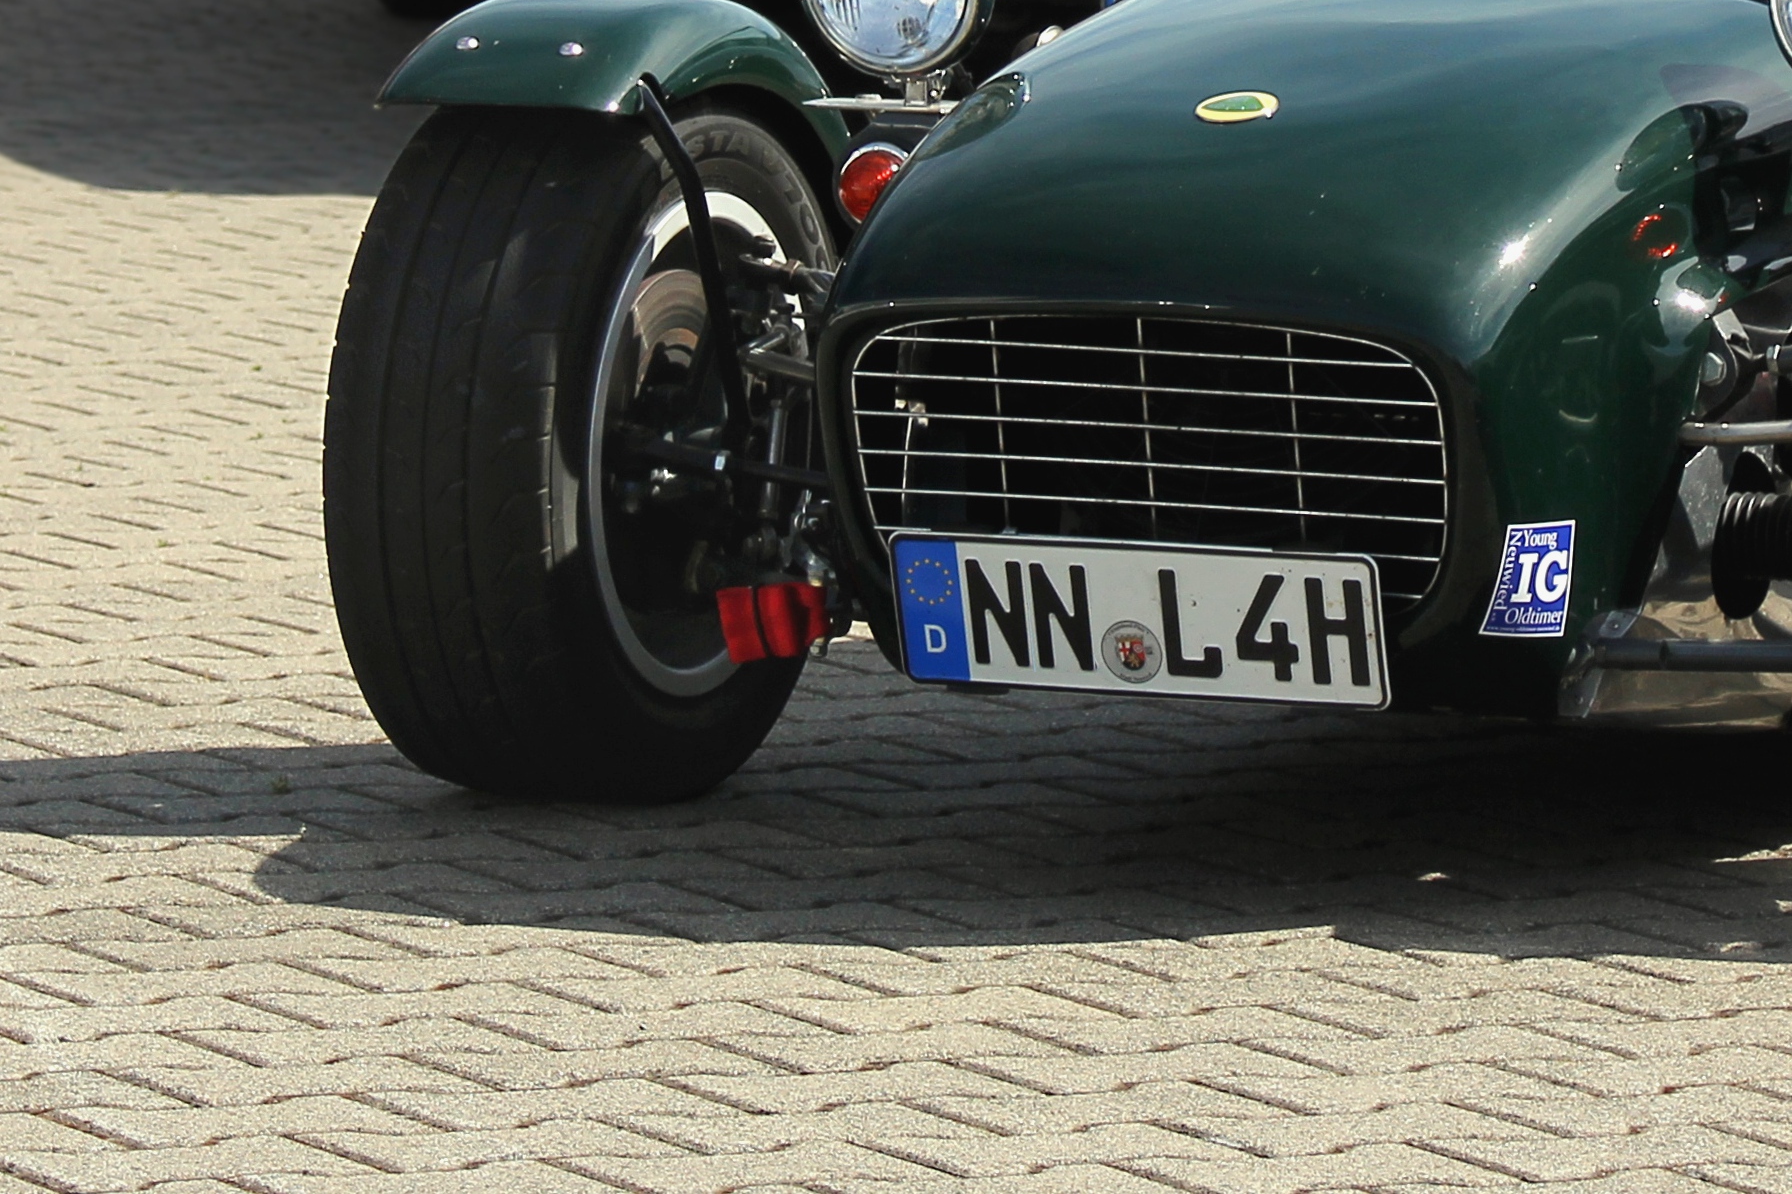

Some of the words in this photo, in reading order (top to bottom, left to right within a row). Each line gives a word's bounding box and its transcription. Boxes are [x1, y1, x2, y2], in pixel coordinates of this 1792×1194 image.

[1523, 529, 1558, 550] Young
[1493, 530, 1523, 610] Neuwied
[1510, 550, 1569, 603] IG
[964, 558, 1097, 671] NN
[1504, 607, 1564, 625] Oldtimer
[924, 624, 947, 653] D
